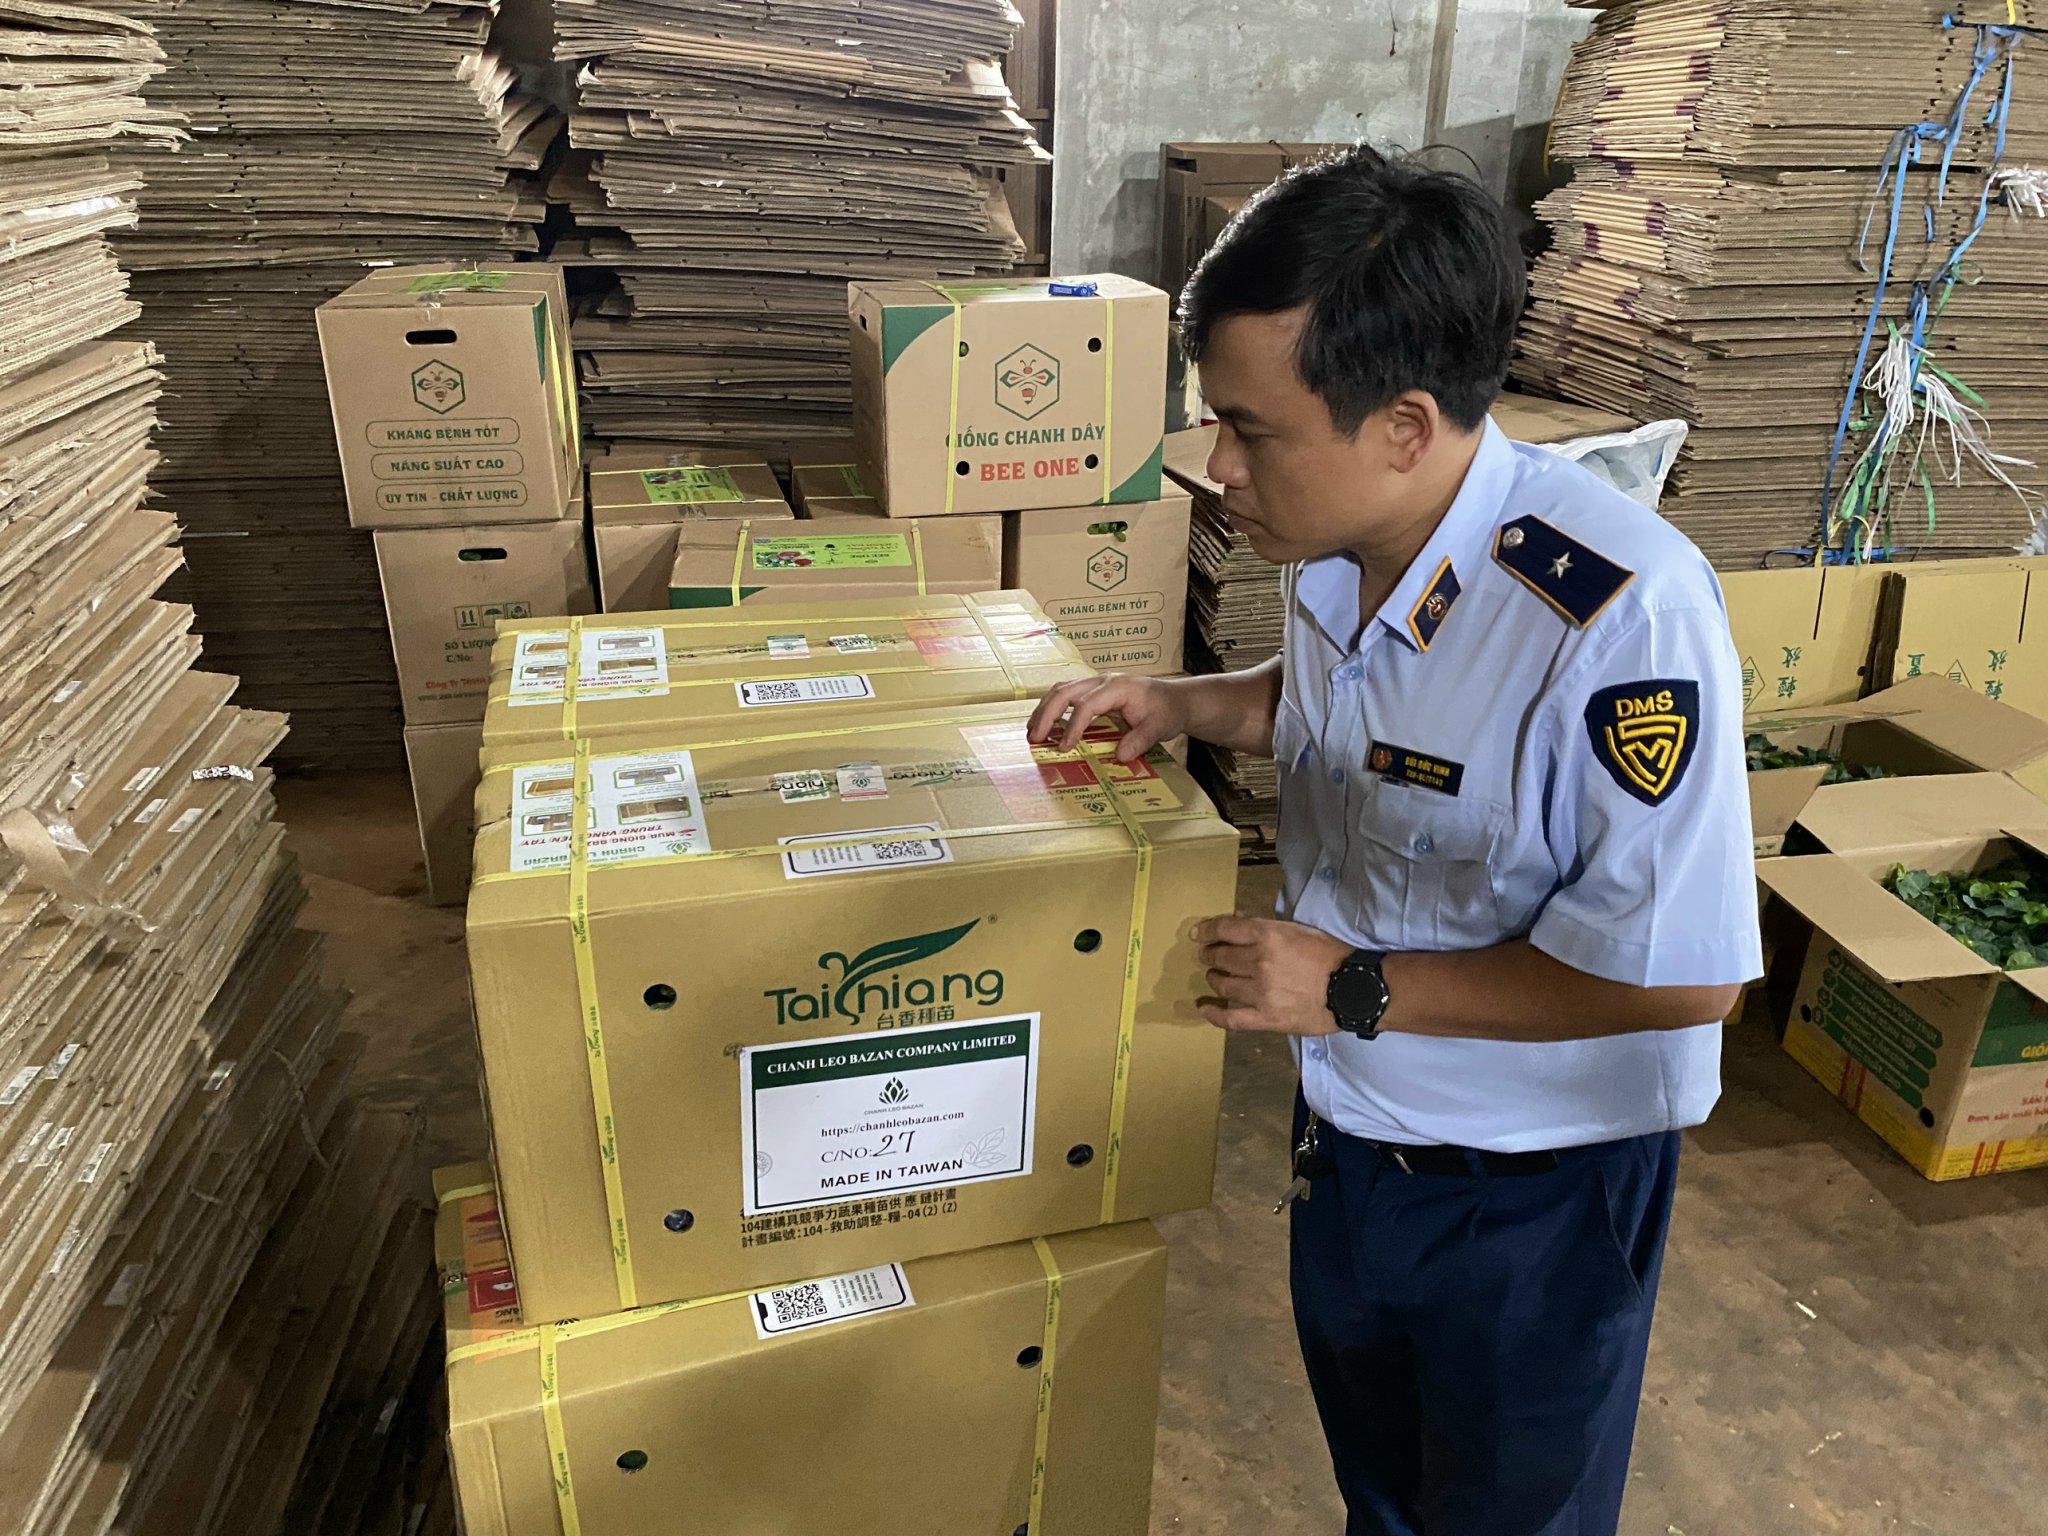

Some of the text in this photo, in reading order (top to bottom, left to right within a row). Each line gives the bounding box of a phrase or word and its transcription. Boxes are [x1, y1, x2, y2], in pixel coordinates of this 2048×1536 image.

[1005, 428, 1065, 445] CHANH
[1072, 423, 1105, 442] DÂY
[477, 459, 504, 470] CAO
[980, 458, 1080, 482] BEE ONE
[386, 494, 401, 504] UY
[1125, 626, 1148, 636] CAO
[1615, 689, 1674, 718] DMS
[877, 1005, 956, 1031] 台香種苗
[767, 1034, 1017, 1075] CHANH LEO BAZAN COMPANY LIMITED
[821, 1111, 965, 1137] https://chanhleobazan.com
[821, 1130, 916, 1164] C/NO: 27
[821, 1159, 964, 1189] MADE IN TAIWAN
